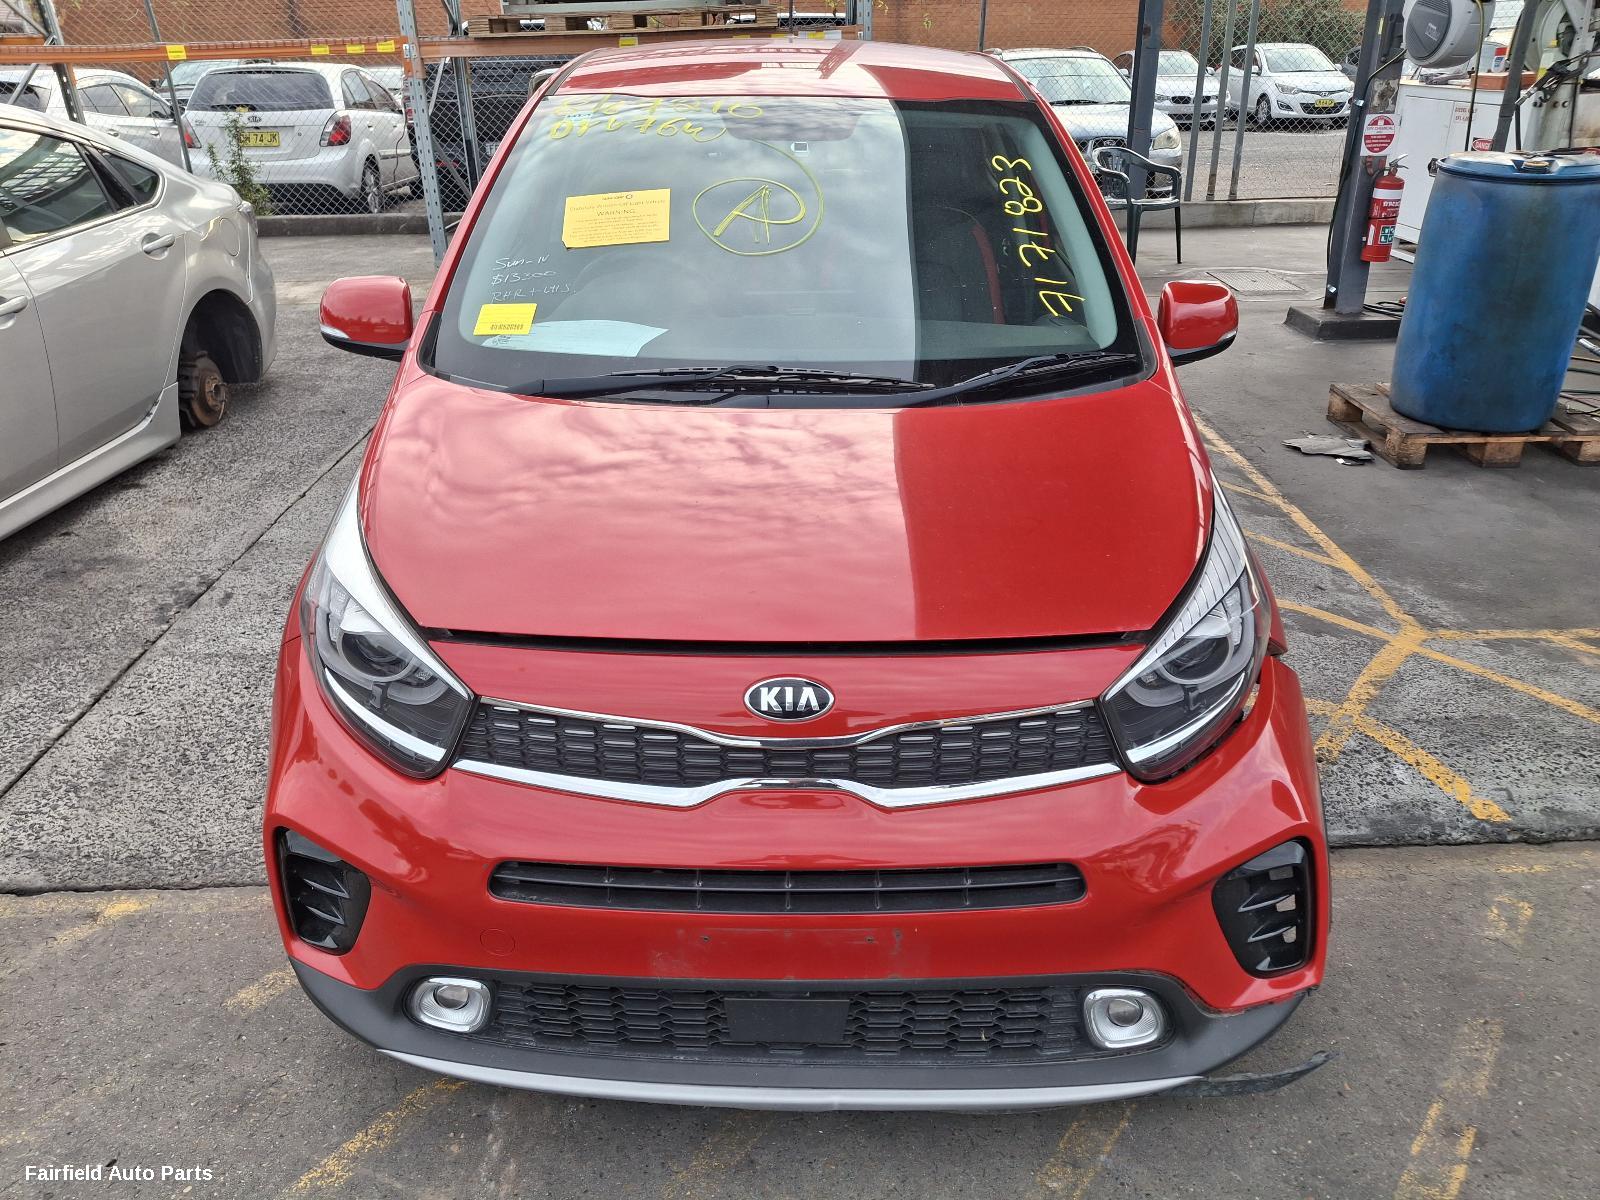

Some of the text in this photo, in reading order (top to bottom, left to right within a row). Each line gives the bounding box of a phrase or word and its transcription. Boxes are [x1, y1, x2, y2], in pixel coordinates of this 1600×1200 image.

[253, 134, 264, 144] 74
[596, 209, 636, 217] WARNING
[759, 686, 820, 712] KIA
